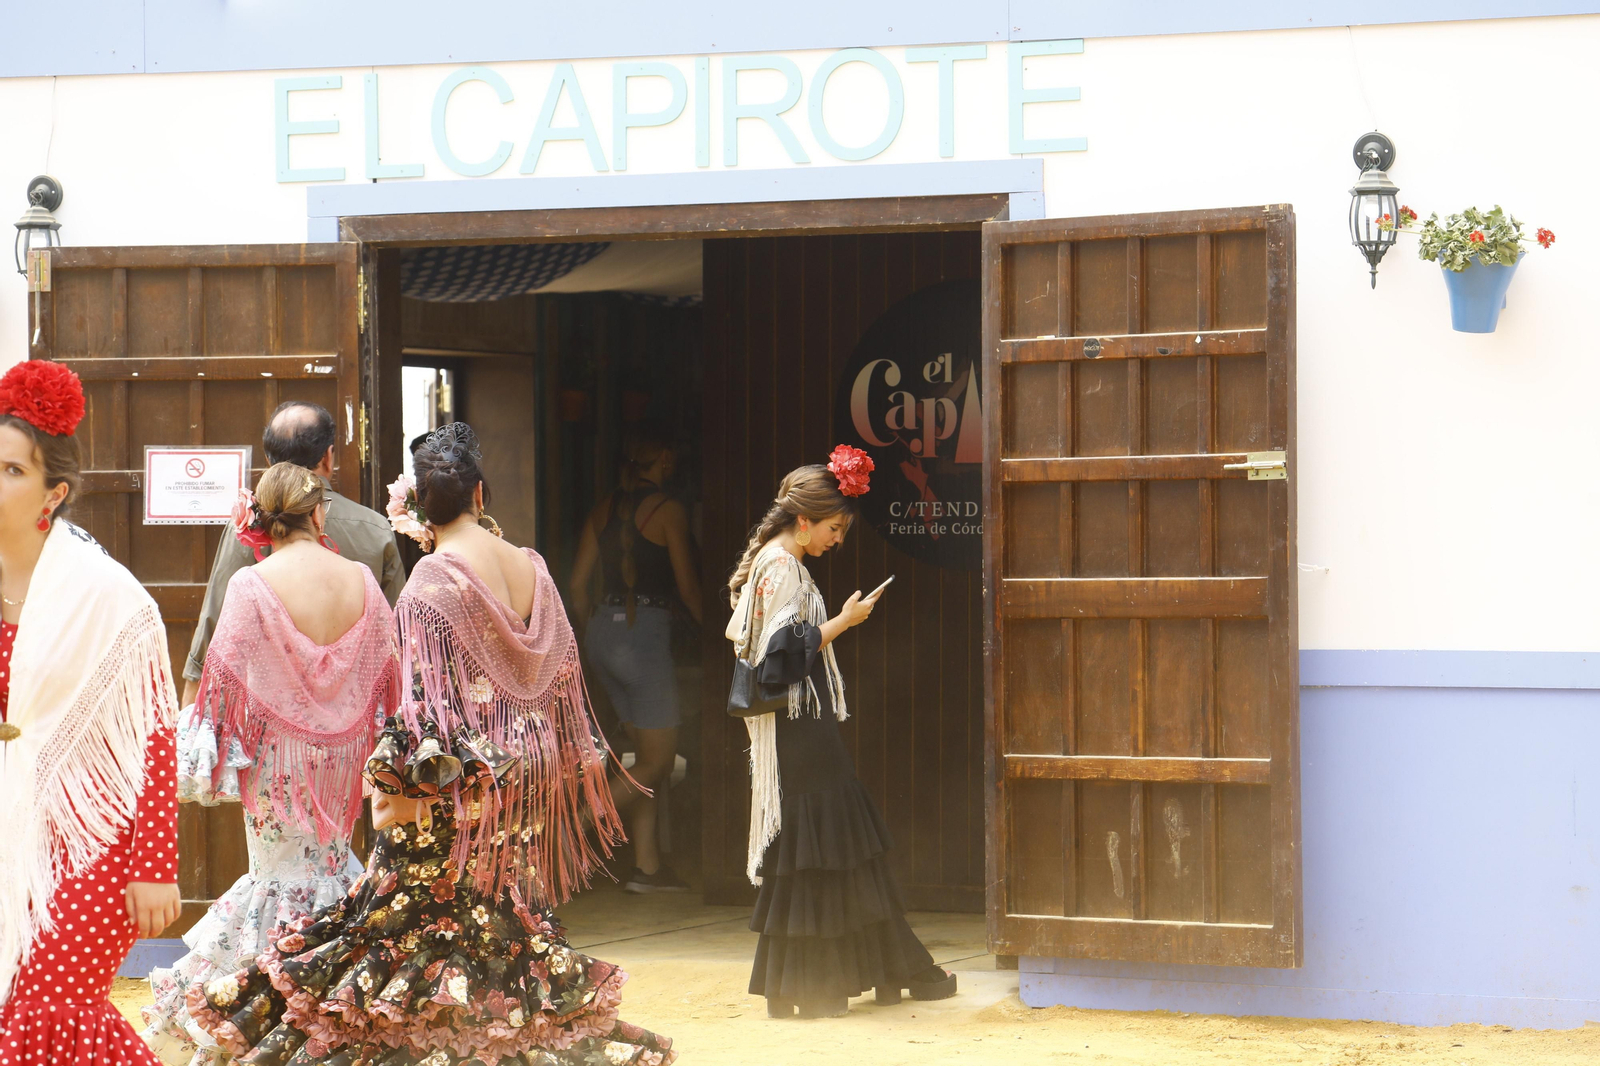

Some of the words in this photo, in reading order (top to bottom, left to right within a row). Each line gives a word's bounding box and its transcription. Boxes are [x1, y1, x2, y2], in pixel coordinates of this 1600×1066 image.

[923, 353, 953, 383] el
[850, 359, 982, 463] Cap
[889, 522, 926, 535] Feria
[930, 522, 947, 535] de
